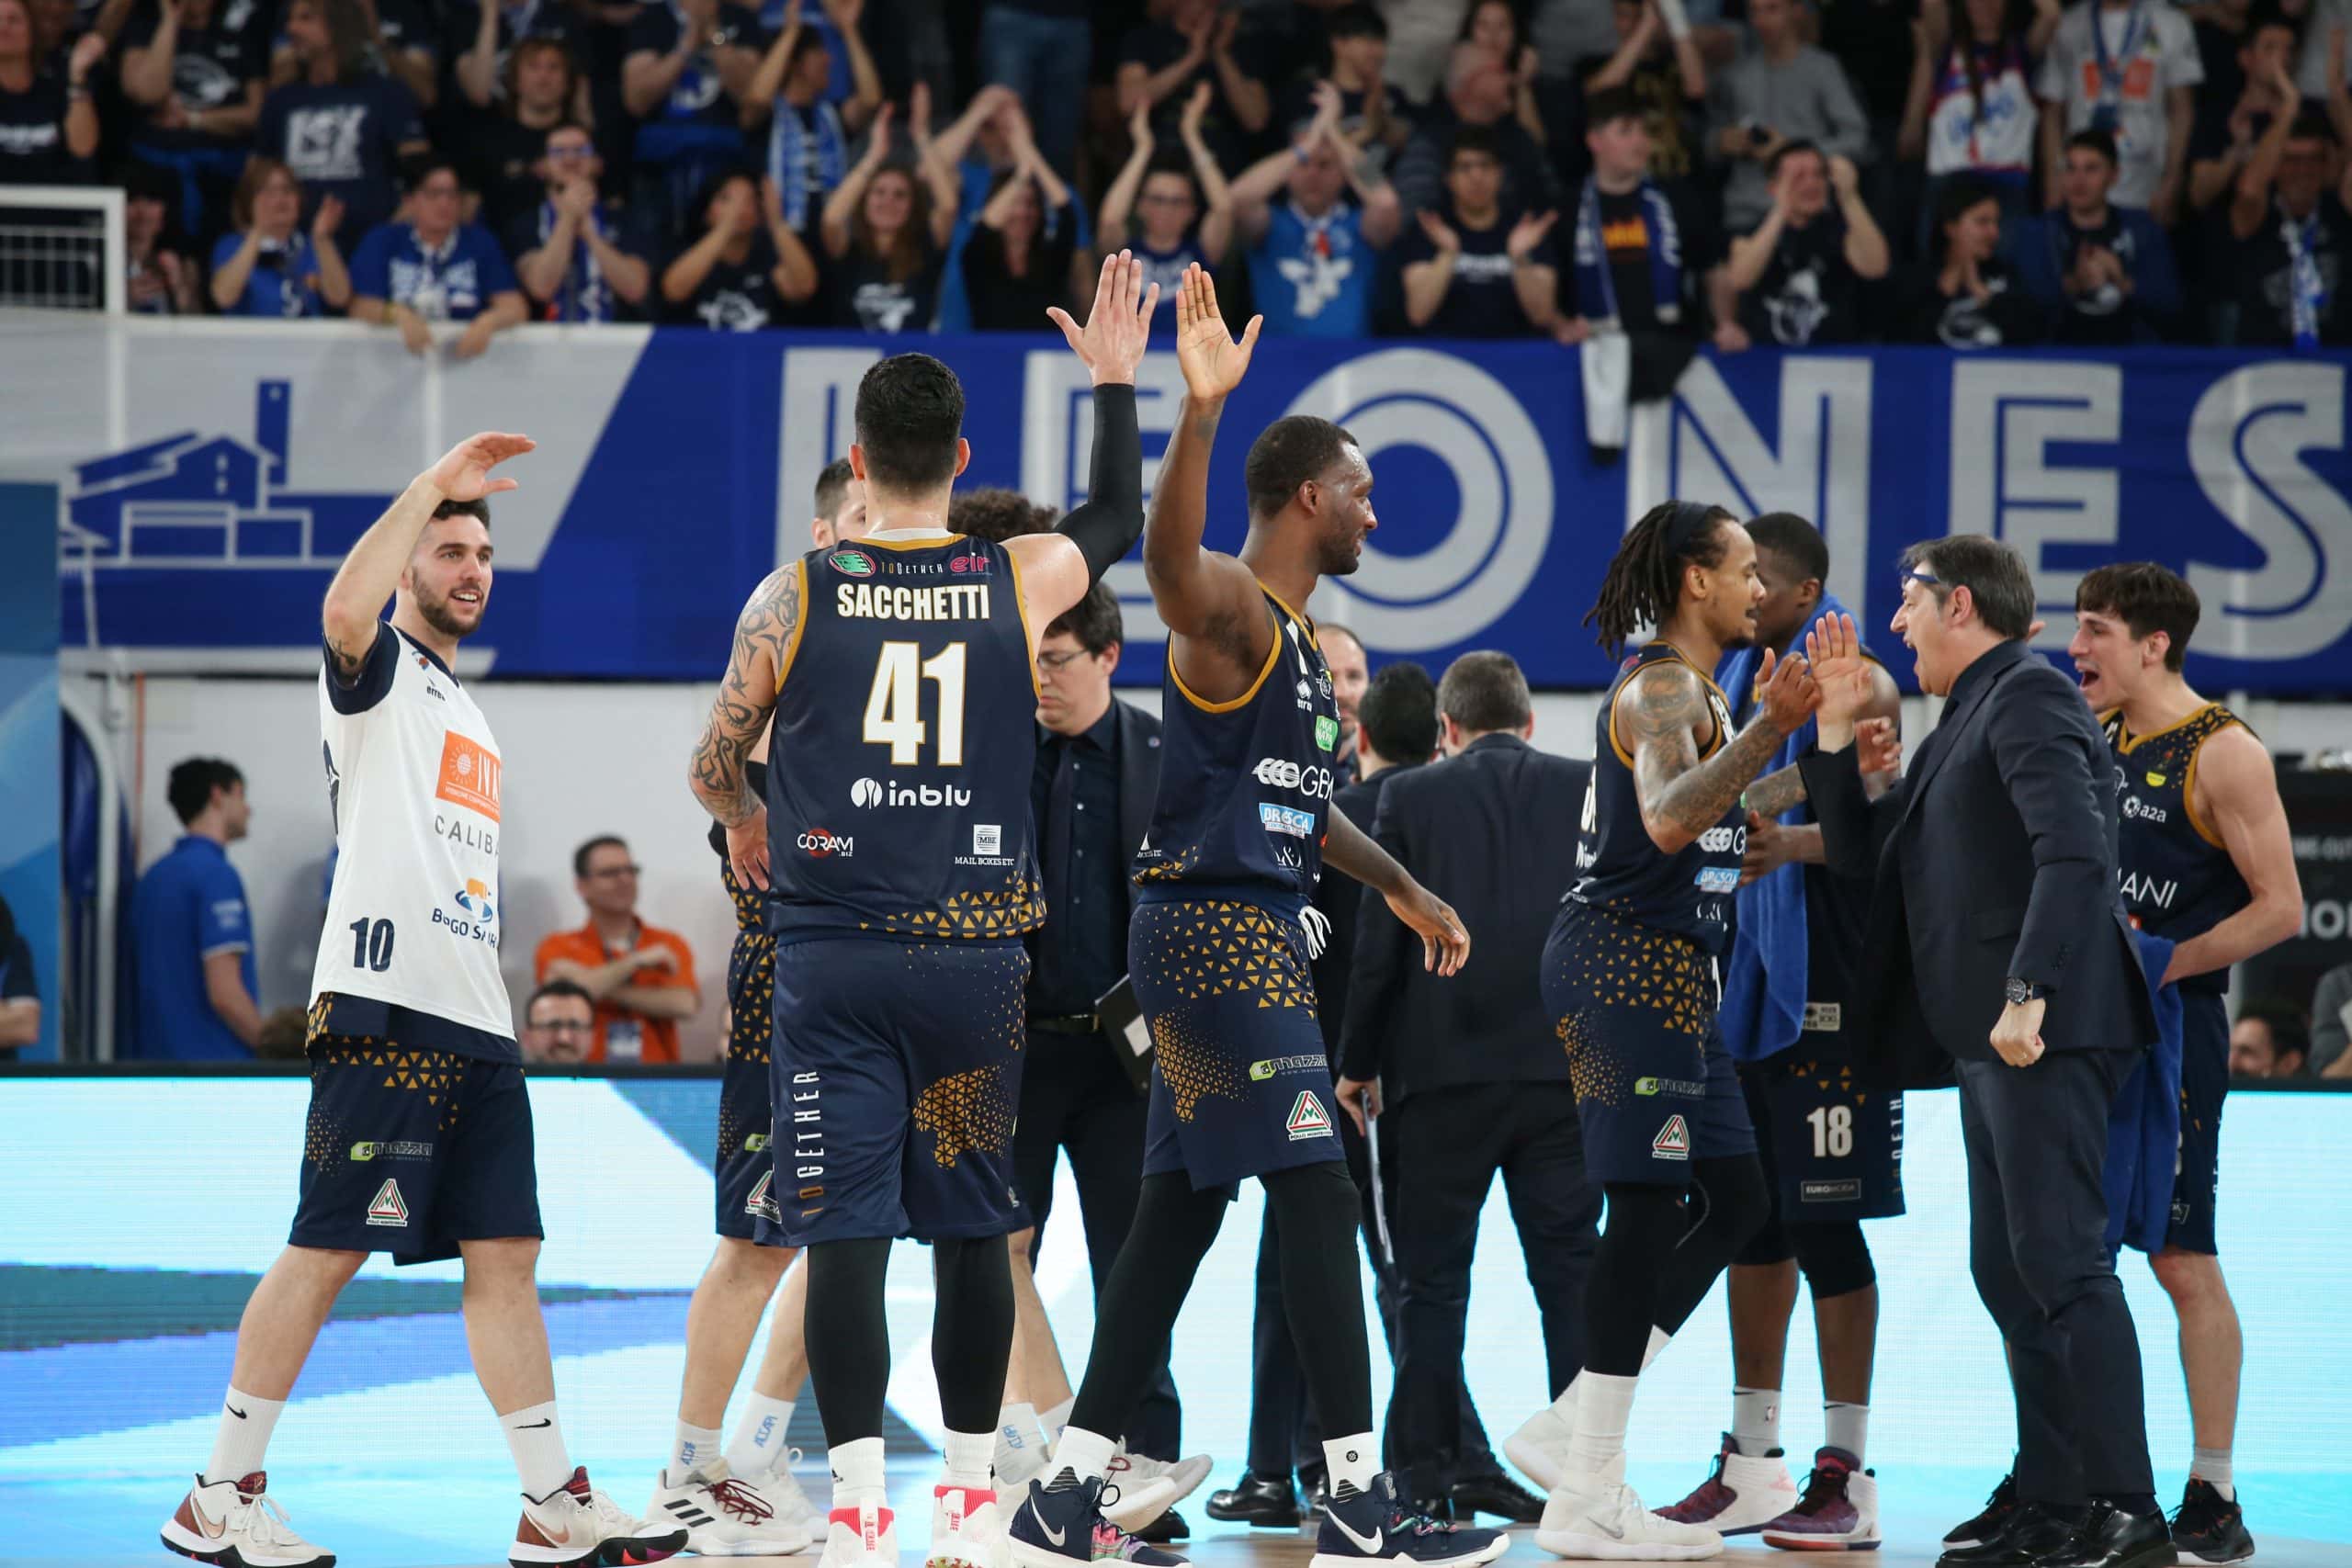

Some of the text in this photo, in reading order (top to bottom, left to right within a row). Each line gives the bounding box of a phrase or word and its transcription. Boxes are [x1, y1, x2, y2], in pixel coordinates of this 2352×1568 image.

[950, 552, 990, 572] eir
[837, 582, 989, 621] SACCHETTI
[862, 640, 967, 766] 41
[888, 780, 971, 807] inblu
[2139, 804, 2166, 823] a2a
[797, 833, 854, 852] CORAM
[955, 856, 977, 865] MAIL
[978, 857, 1001, 866] BOXES
[2117, 867, 2178, 909] ANI
[349, 917, 395, 973] 10
[1806, 1105, 1853, 1158] 18
